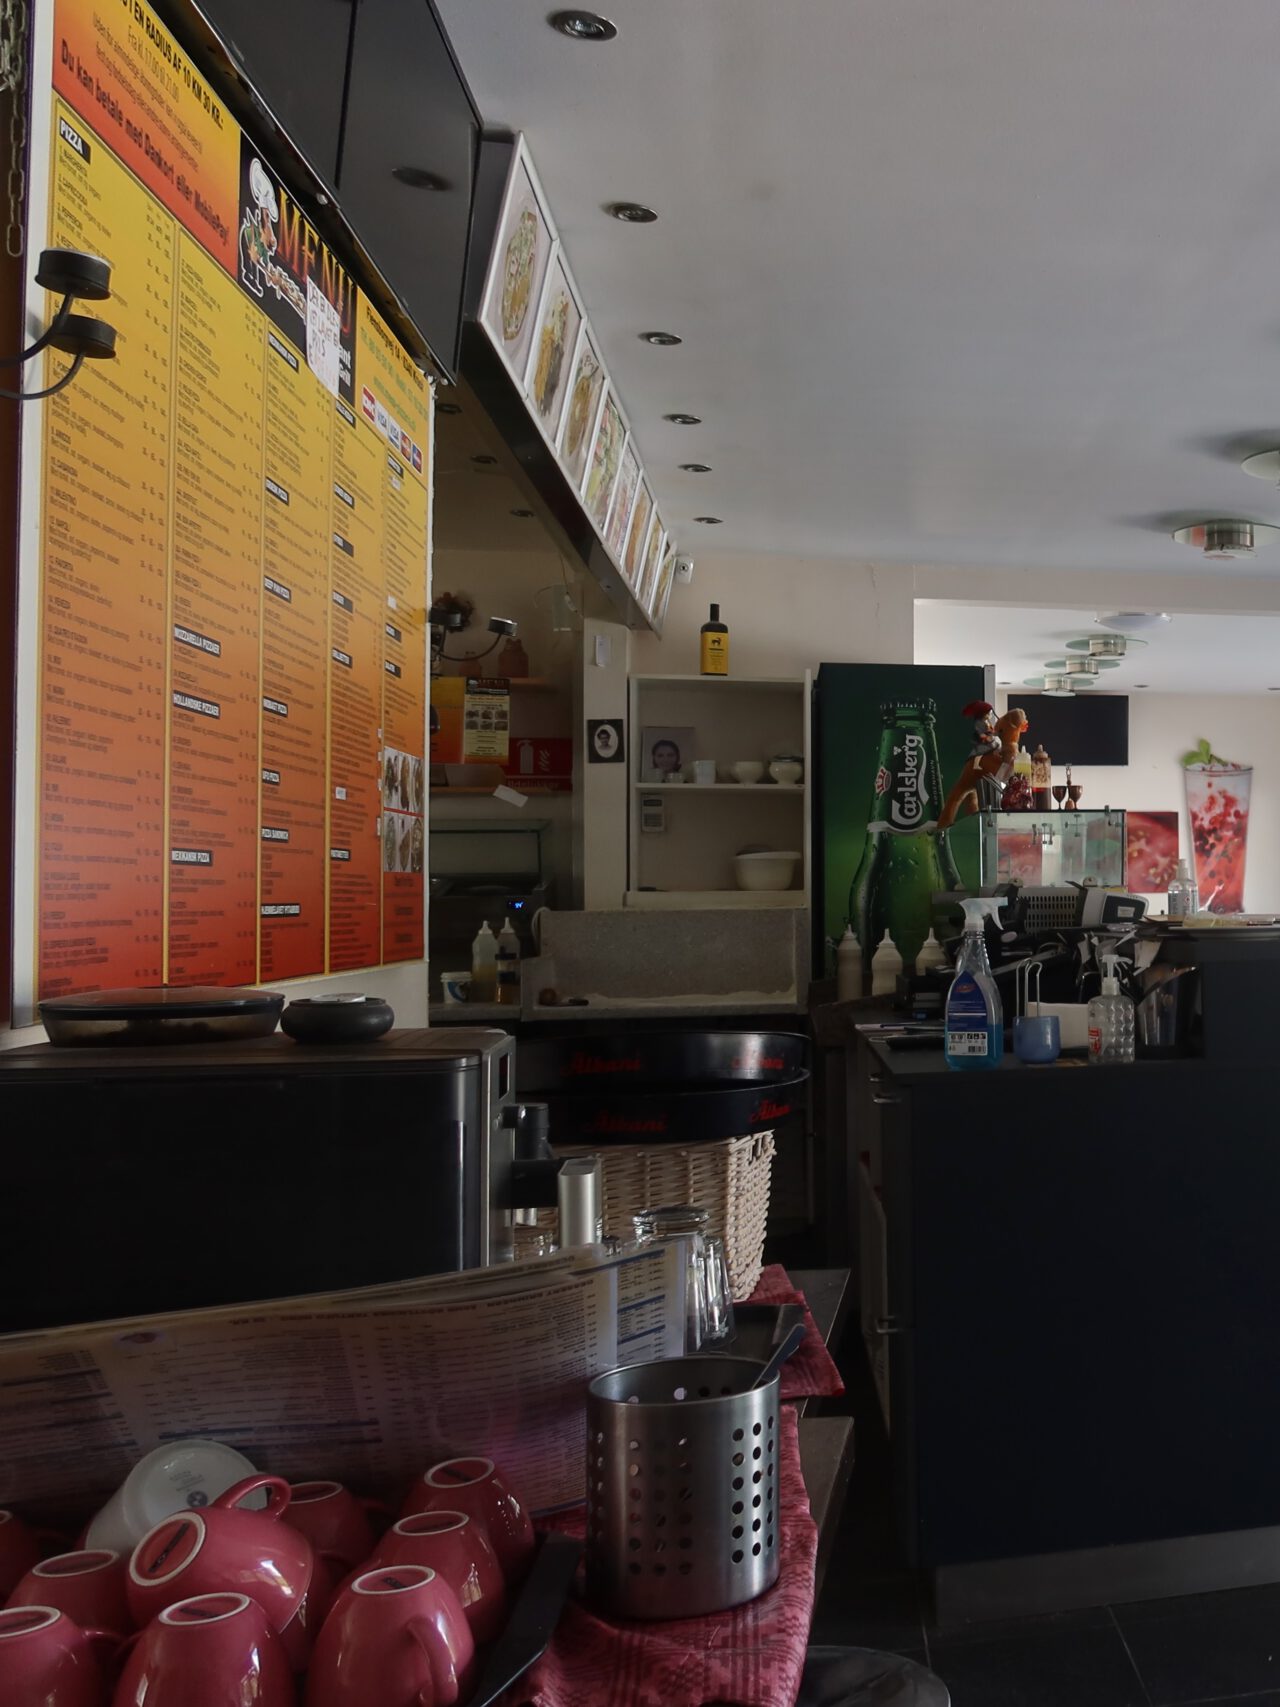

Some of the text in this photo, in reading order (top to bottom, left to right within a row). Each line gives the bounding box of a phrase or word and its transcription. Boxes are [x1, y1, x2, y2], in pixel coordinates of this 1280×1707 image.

[145, 15, 172, 62] RADIUS
[172, 53, 183, 75] AF
[183, 66, 191, 88] 10
[191, 75, 202, 102] KM
[60, 118, 82, 155] PIZZA
[61, 35, 74, 76] Du
[77, 54, 93, 97] kan
[96, 77, 123, 129] betale
[126, 110, 143, 151] med
[144, 131, 174, 186] Dankort
[176, 168, 192, 206] eller
[278, 186, 354, 336] MENU
[173, 692, 201, 711] HOLLANDSKE
[892, 734, 926, 825] Carlsberg
